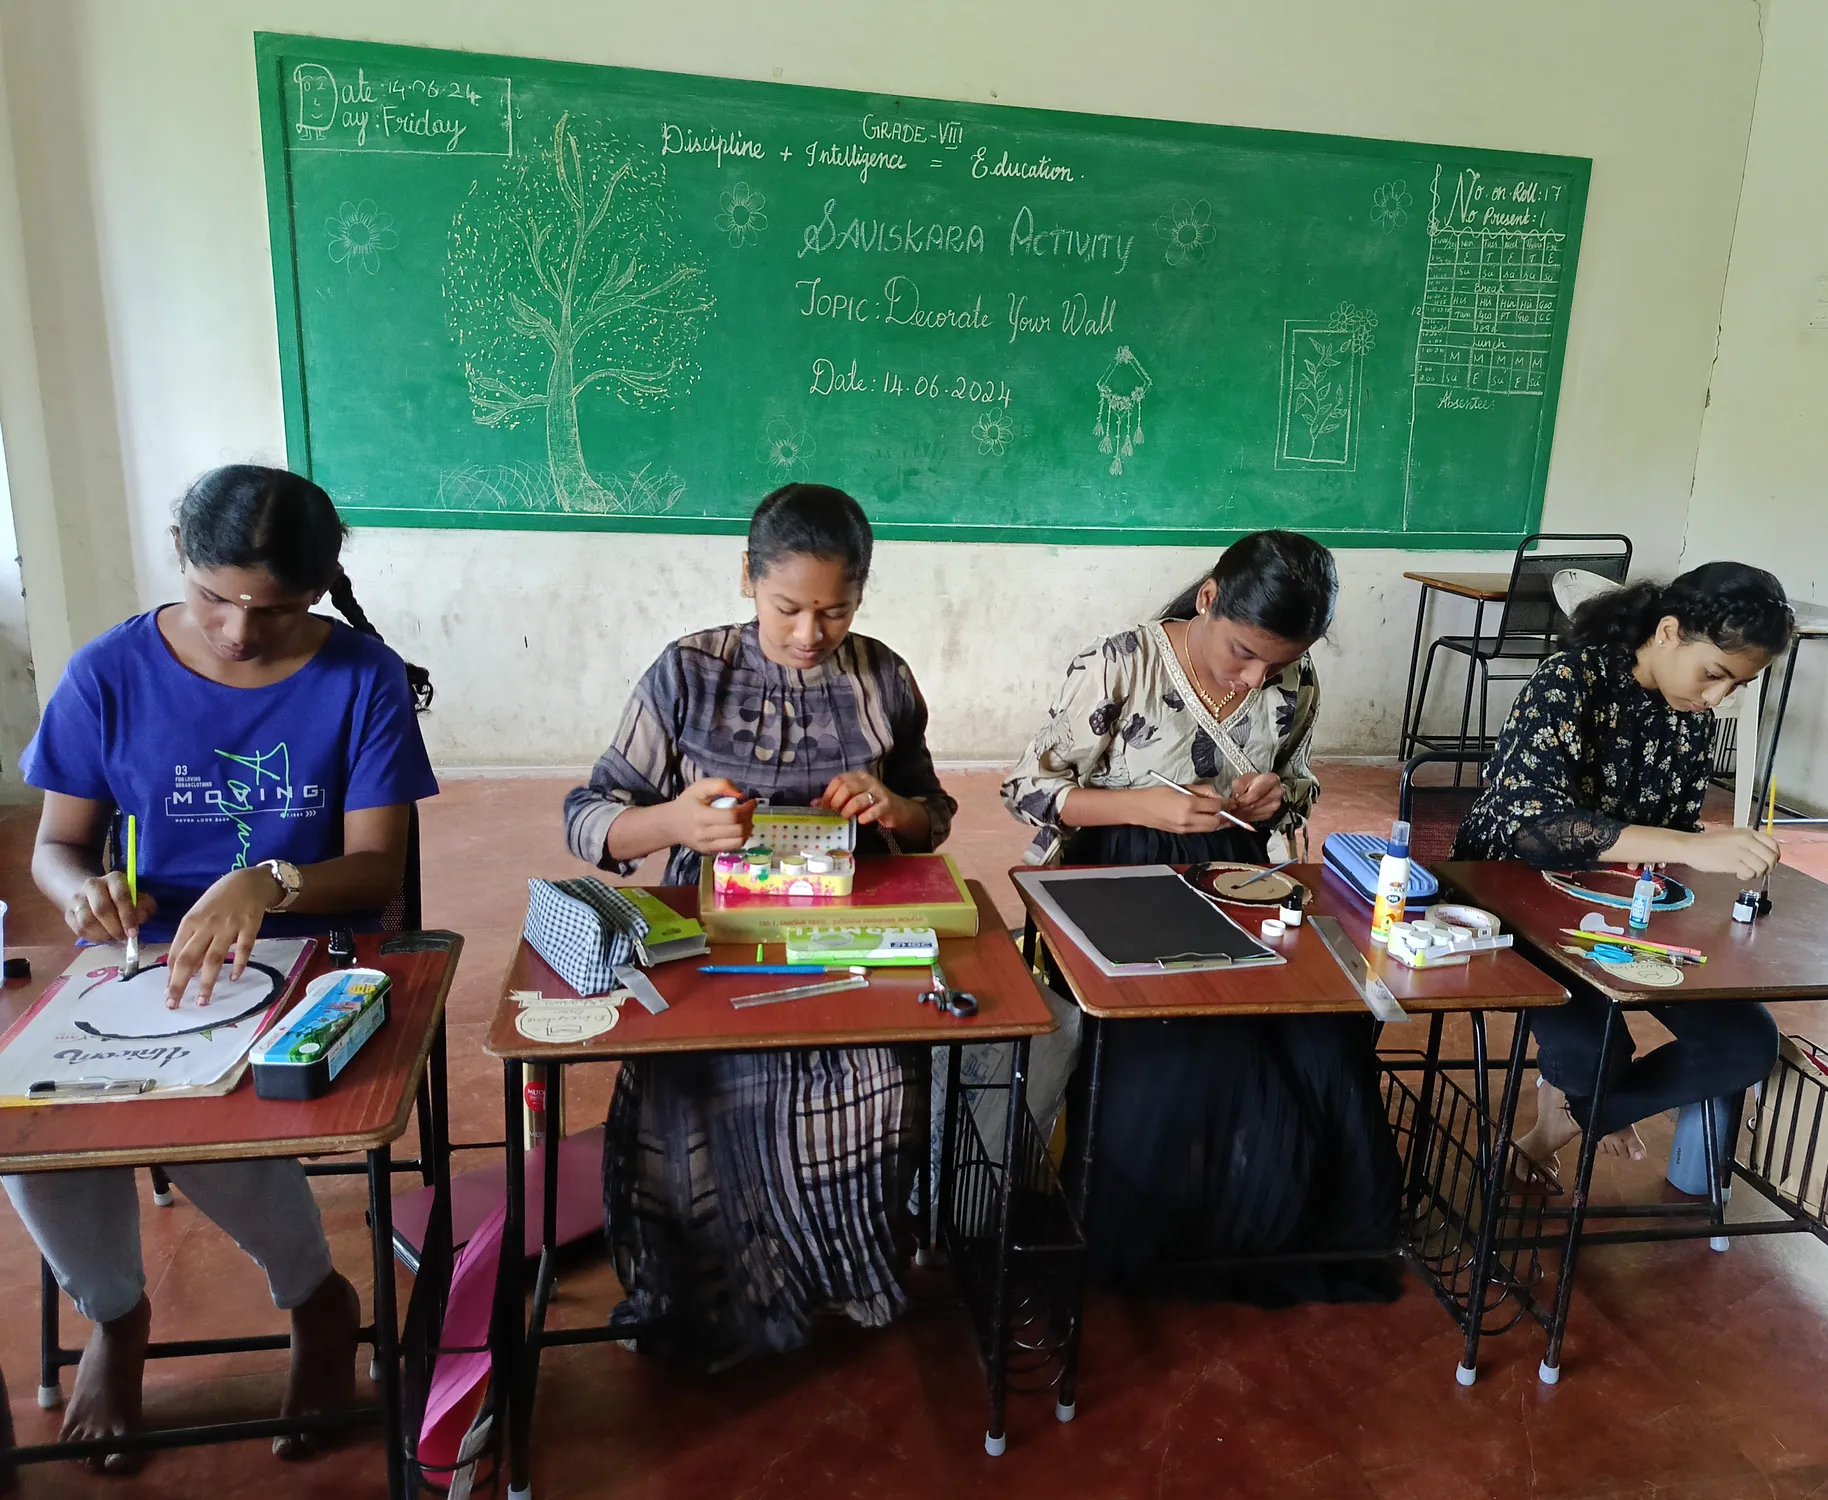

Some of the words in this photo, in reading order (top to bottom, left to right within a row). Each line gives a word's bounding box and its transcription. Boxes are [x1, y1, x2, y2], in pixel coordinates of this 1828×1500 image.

[661, 122, 765, 168] Discipline
[804, 141, 908, 183] Intelligence
[1473, 282, 1505, 294] Break
[884, 274, 994, 329] Decorate
[1007, 292, 1052, 344] Your
[1061, 292, 1117, 336] Wall
[1472, 336, 1507, 349] Lunch
[1449, 351, 1460, 362] M
[1473, 354, 1484, 364] M
[1496, 356, 1506, 365] M
[1514, 357, 1524, 366] M
[1532, 358, 1543, 369] M
[175, 764, 188, 776] 03
[172, 784, 319, 804] MOVING
[527, 1088, 546, 1097] MILTO
